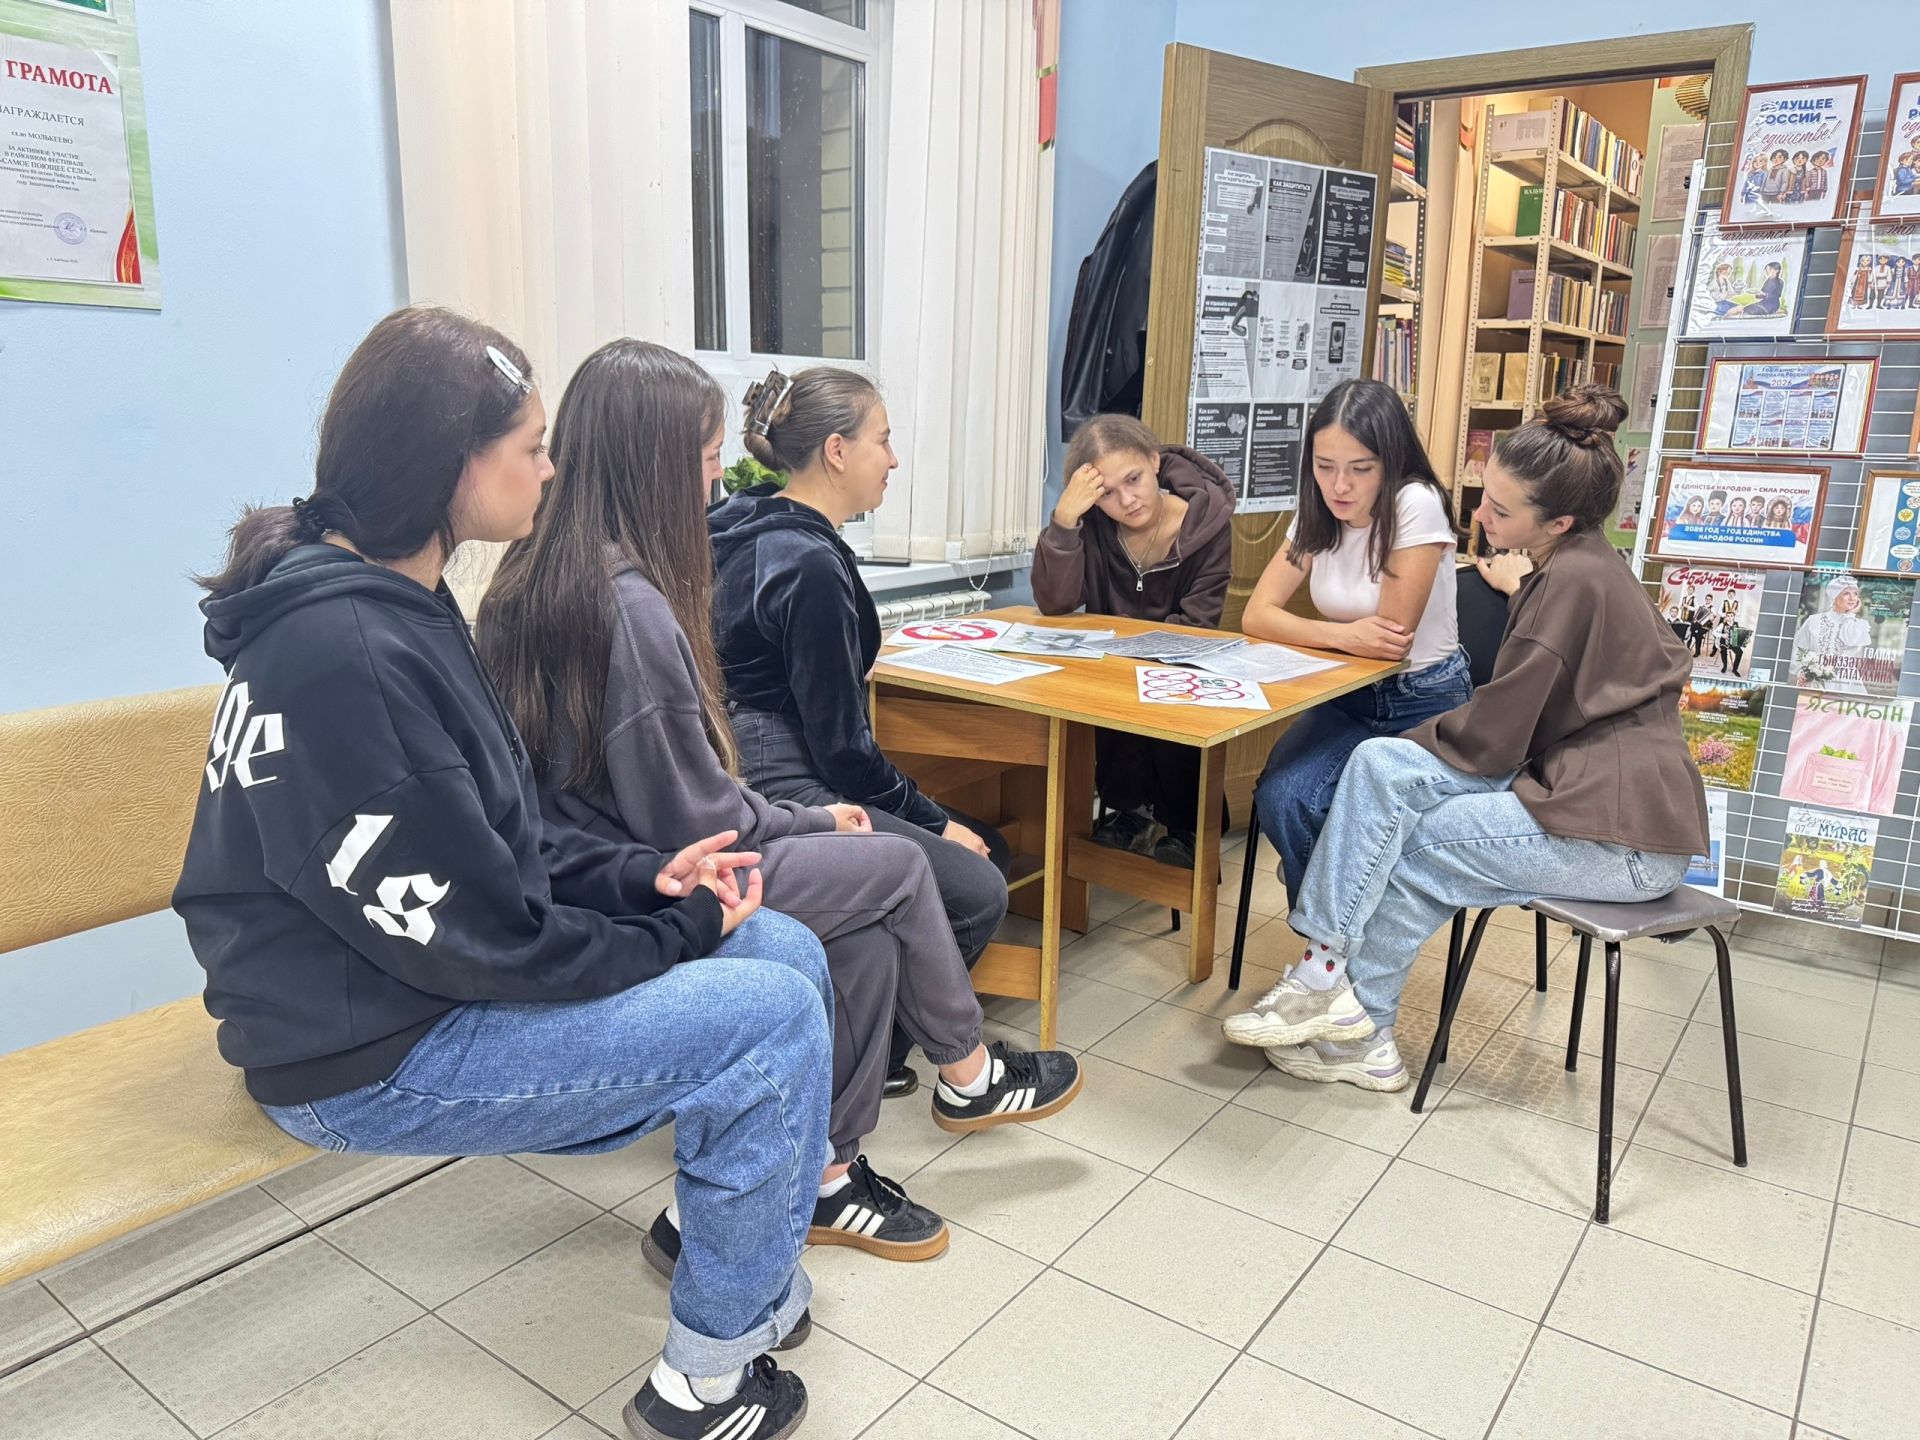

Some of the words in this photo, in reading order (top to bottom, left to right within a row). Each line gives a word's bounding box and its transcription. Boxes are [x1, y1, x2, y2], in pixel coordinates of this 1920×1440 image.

[5, 59, 114, 95] ГРАМОТА
[1760, 98, 1834, 112] ДУЩЕЕ
[0, 104, 85, 126] АГРАЖДАЕТСЯ
[1757, 112, 1821, 125] ОССИИ
[28, 132, 74, 145] МОЛЬКЕЕВО
[17, 146, 50, 156] АКТИВНОЕ
[51, 151, 80, 160] УЧАСТИЕ
[31, 161, 66, 172] ПОЮЩЕЕ
[1771, 379, 1793, 387] 2026
[1735, 536, 1764, 544] РОССИИ
[1804, 696, 1904, 723] ЯЛКЫН
[1818, 823, 1868, 844] МИРАС
